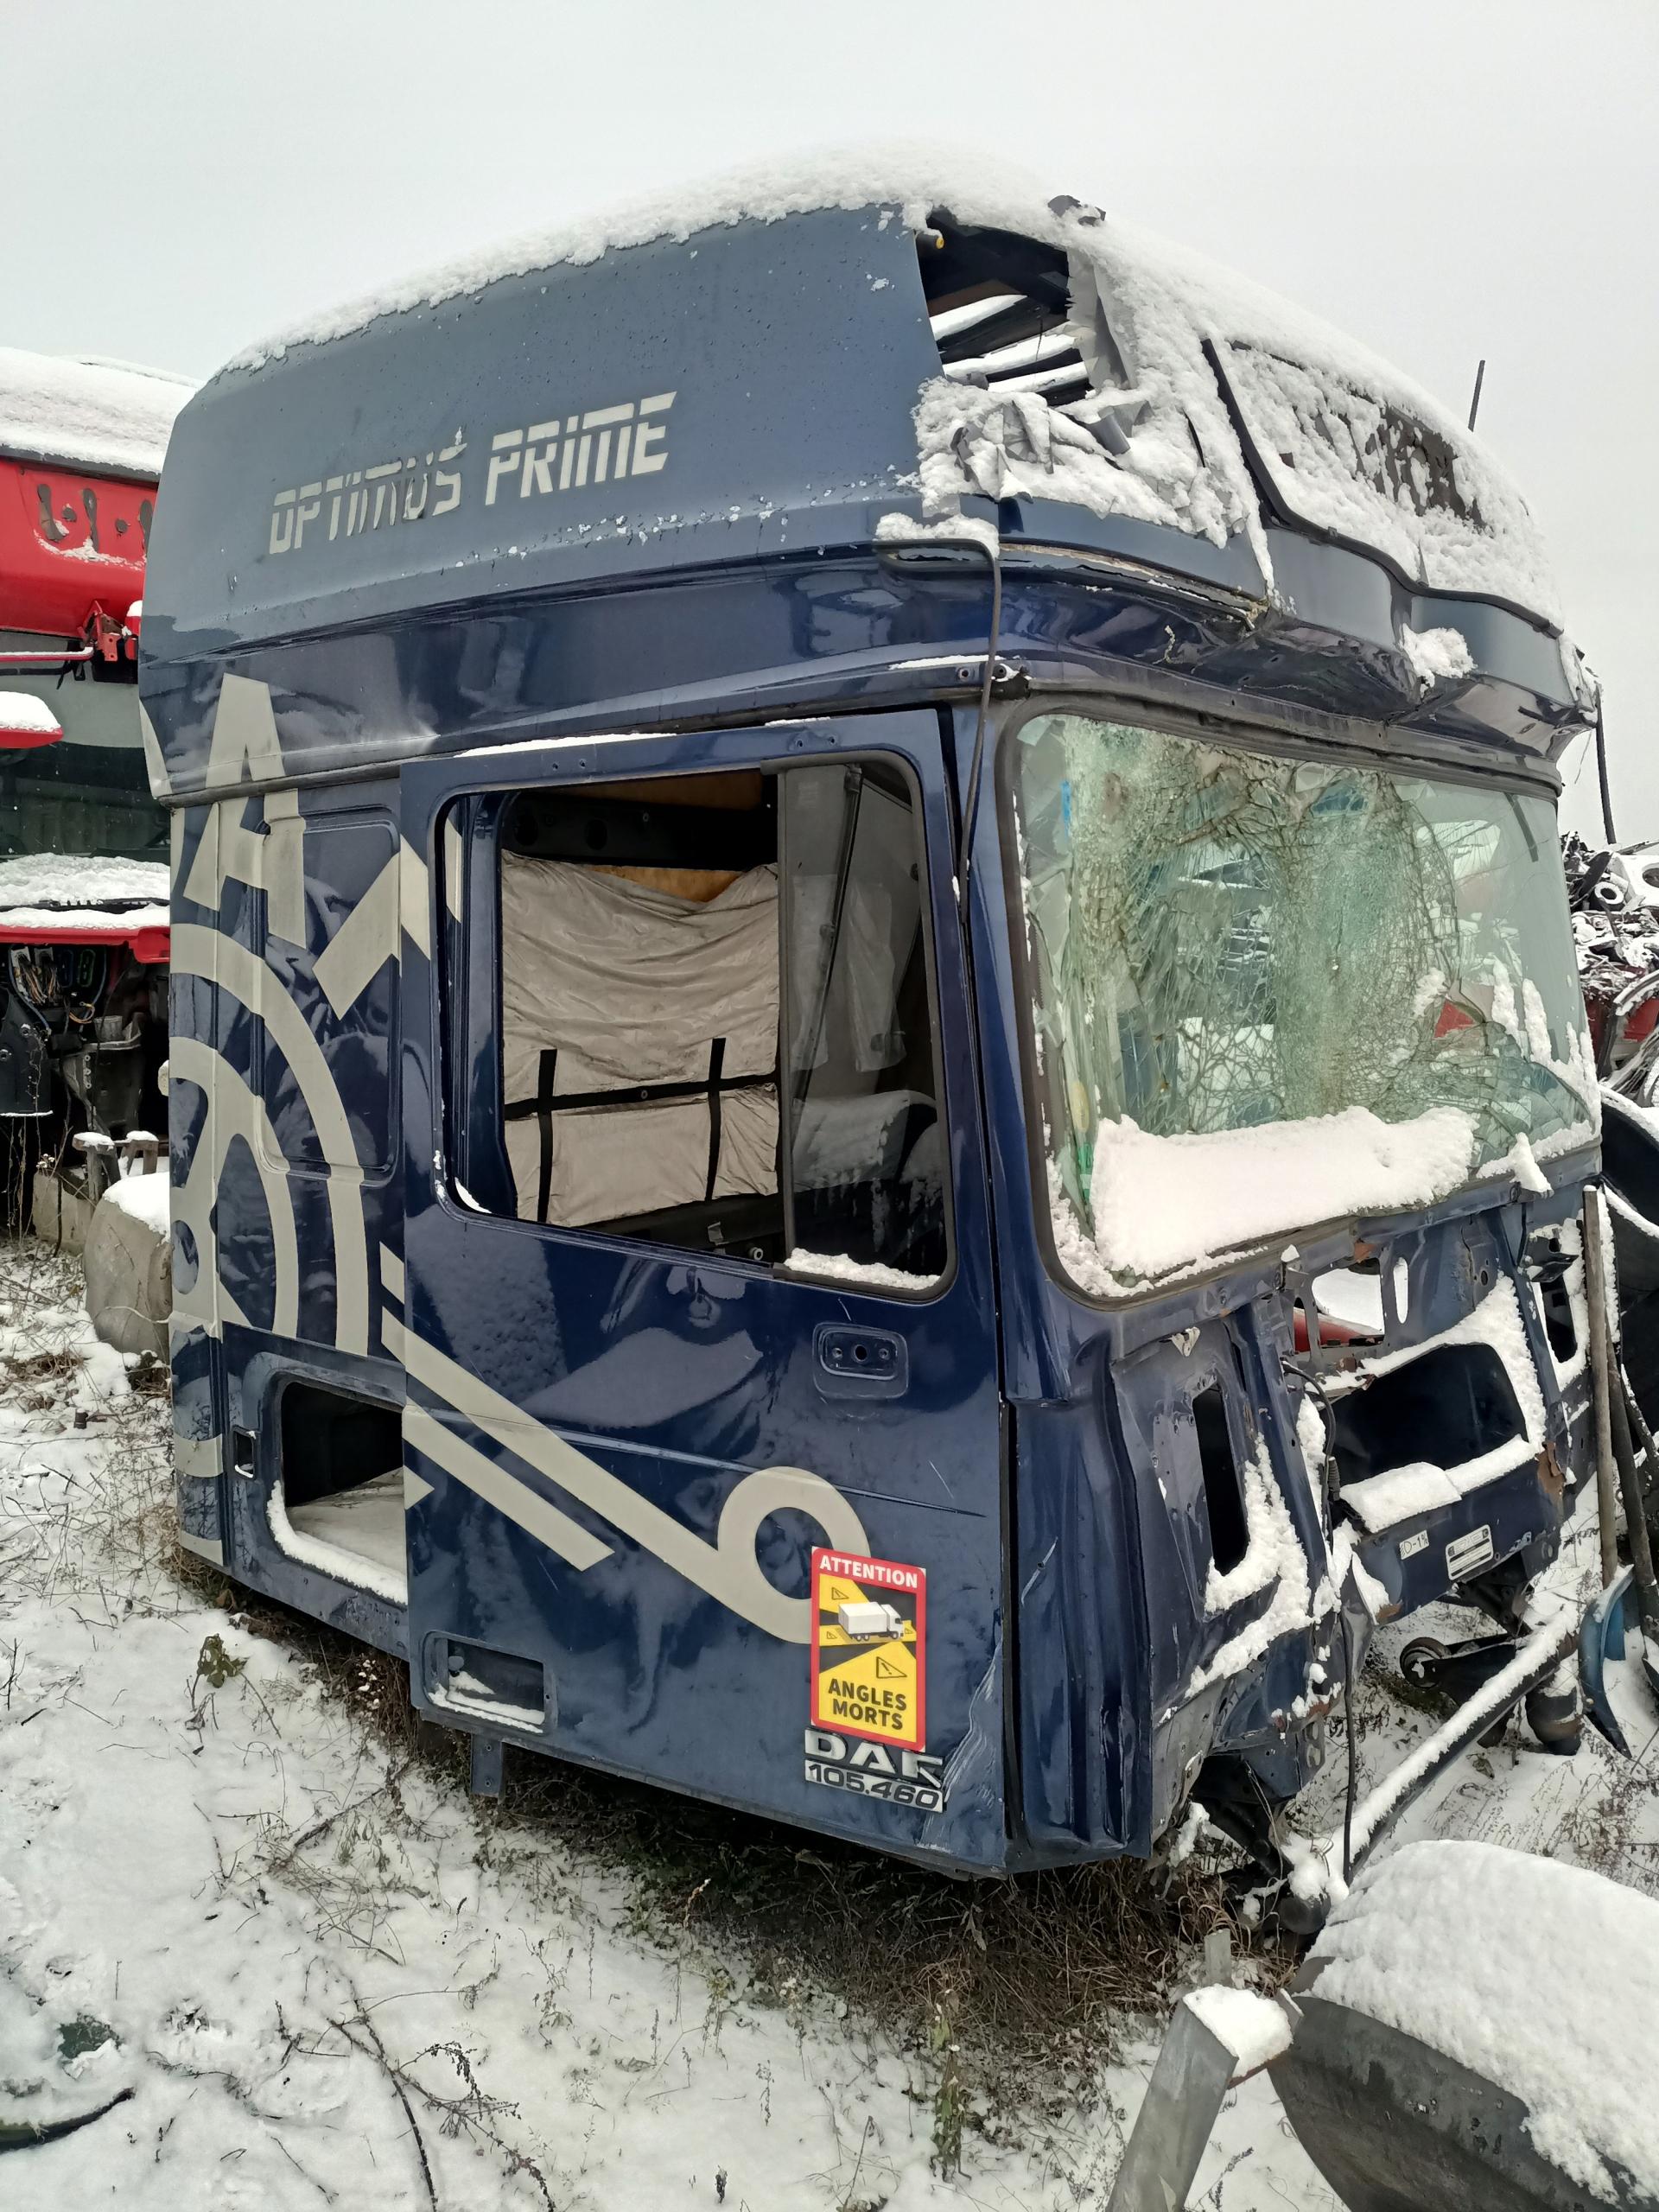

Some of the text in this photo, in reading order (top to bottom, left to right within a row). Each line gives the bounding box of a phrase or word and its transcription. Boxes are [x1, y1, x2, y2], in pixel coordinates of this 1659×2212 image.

[270, 391, 677, 554] OPTIMUS PRIME
[819, 1554, 918, 1589] ATTENTION
[828, 1678, 907, 1712] ANGLES
[832, 1698, 904, 1731] MORTS
[804, 1728, 944, 1789] DAF
[807, 1764, 940, 1811] 105.460
